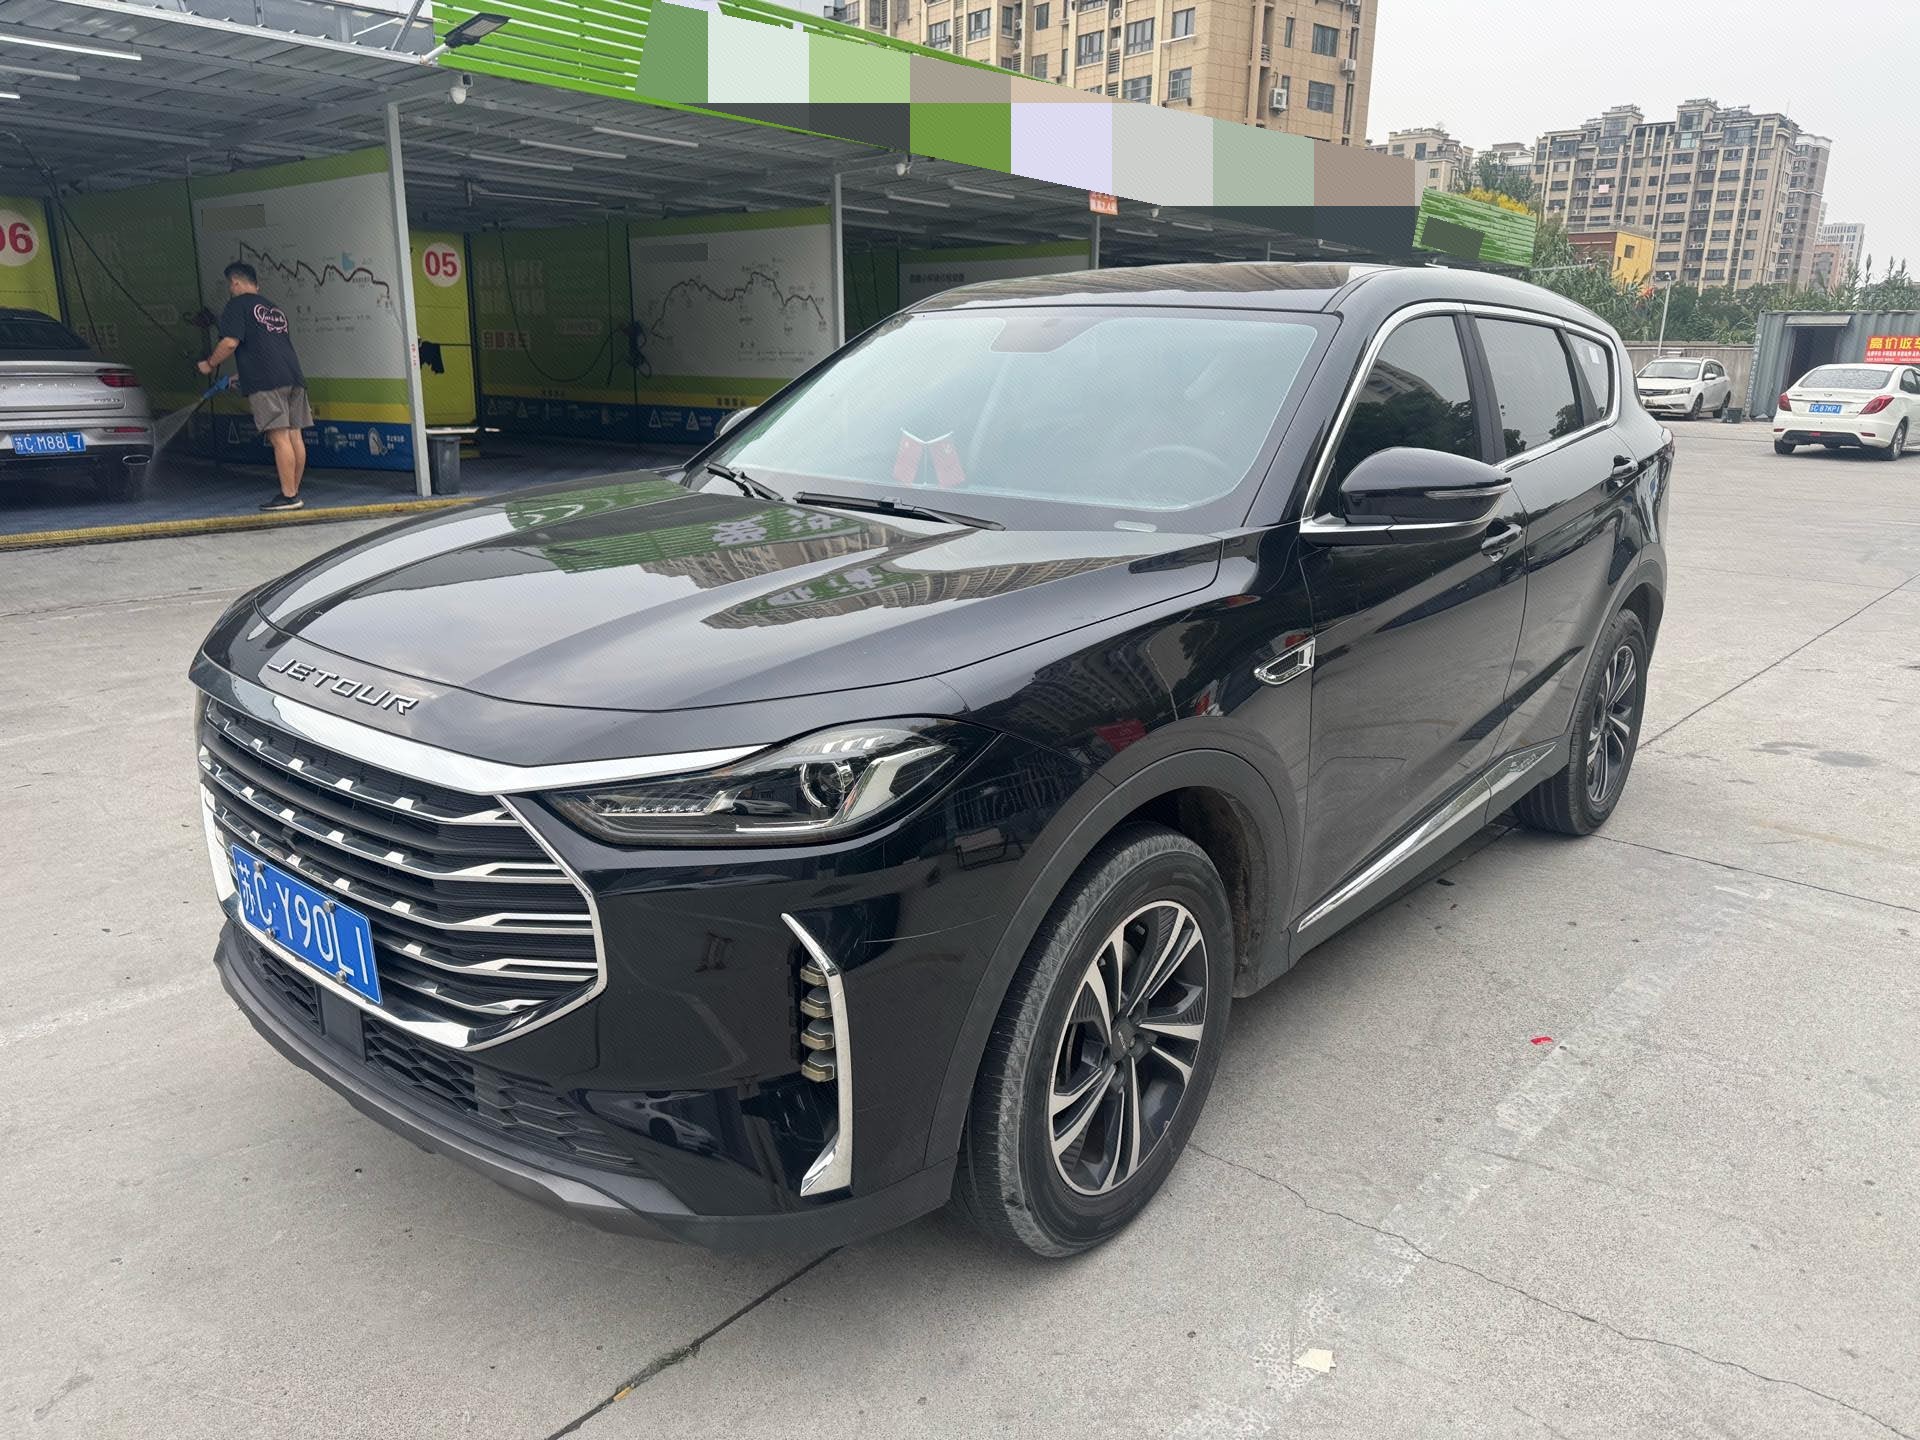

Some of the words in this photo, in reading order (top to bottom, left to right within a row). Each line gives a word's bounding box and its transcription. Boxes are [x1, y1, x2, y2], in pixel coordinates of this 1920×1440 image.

[0, 223, 33, 254] 6
[424, 251, 458, 277] 05
[267, 658, 419, 715] JETOUR
